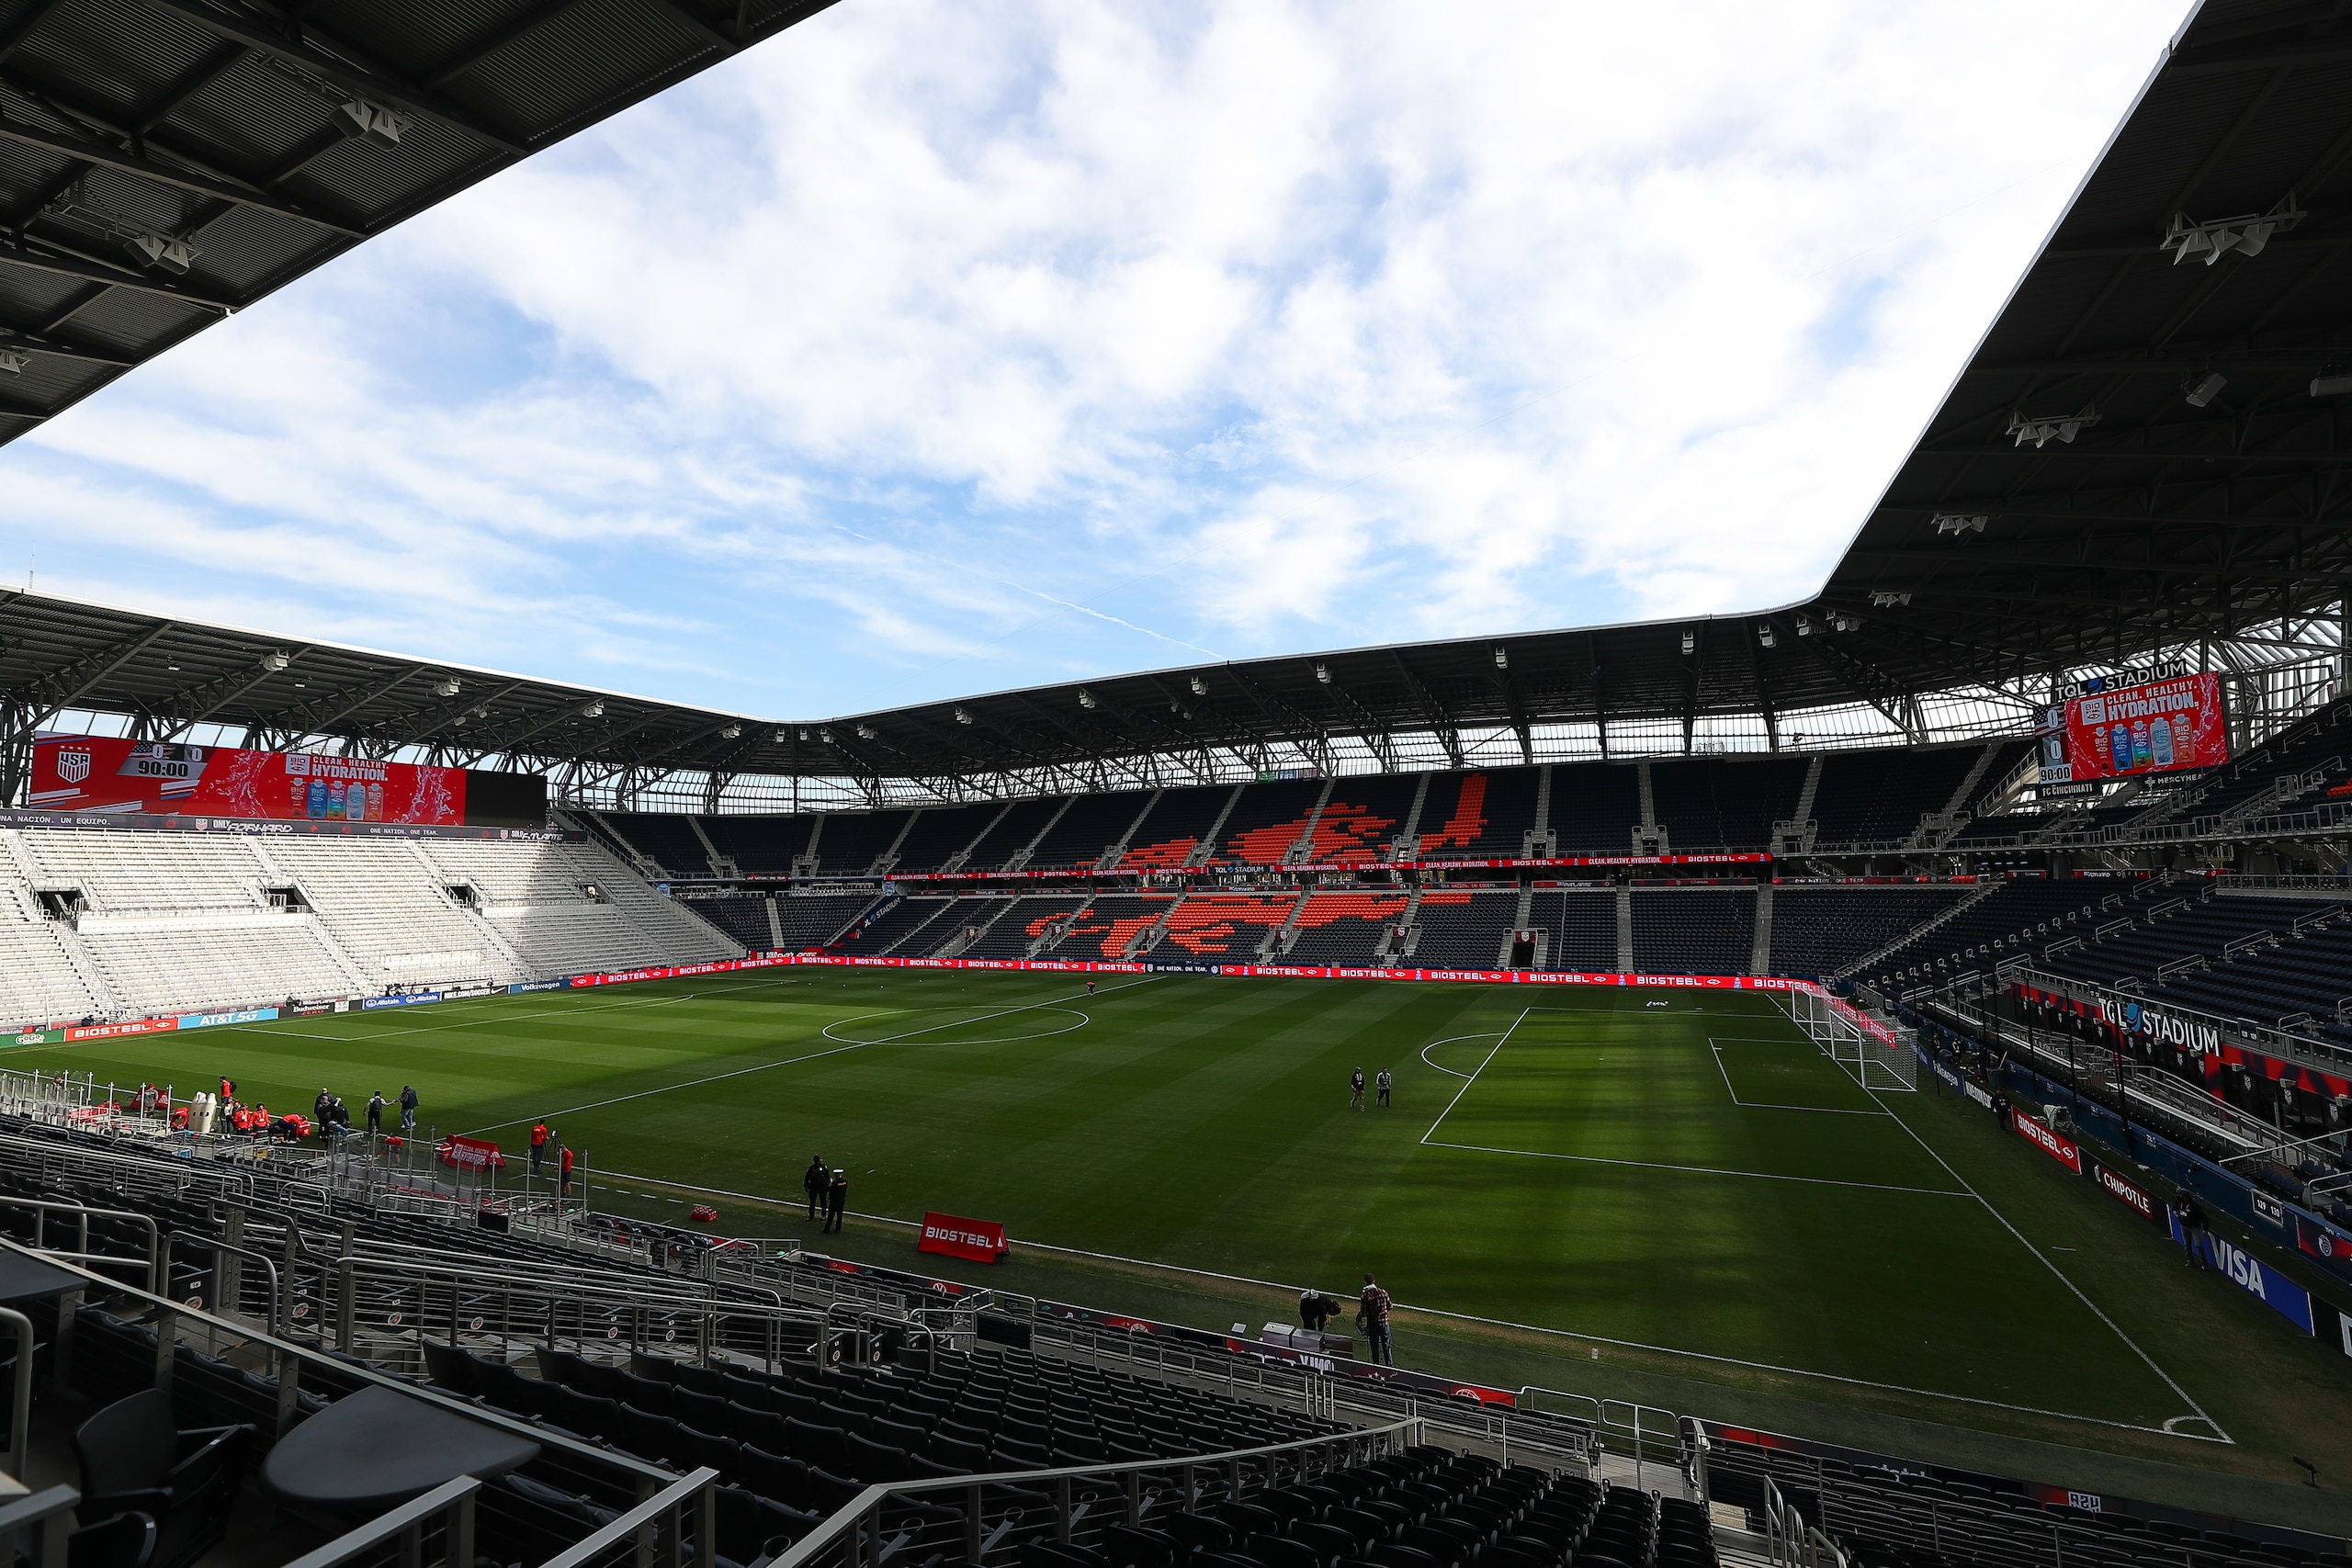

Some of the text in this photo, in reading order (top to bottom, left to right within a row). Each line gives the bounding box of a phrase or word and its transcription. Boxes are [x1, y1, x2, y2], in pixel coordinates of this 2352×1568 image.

[2055, 661, 2186, 700] TQL STADIUM
[2107, 681, 2197, 705] CLEAN. HEALTHY.
[2108, 692, 2199, 721] HYDRATION.
[2047, 709, 2058, 728] 0
[192, 748, 202, 761] 0
[2050, 740, 2062, 759] 0
[61, 753, 89, 766] USA
[313, 756, 390, 769] CLEAN. HEALTHY.
[138, 760, 189, 778] 90:00
[312, 764, 389, 781] HYDRATION.
[2040, 766, 2070, 781] 90:00
[2157, 773, 2206, 784] MERCYHEA
[2042, 784, 2093, 796] FC CINCINNATI
[17, 815, 54, 823] NACIÓN.
[227, 822, 293, 832] FORWARD
[876, 897, 901, 919] STADIUM
[679, 965, 716, 975] BIOSTEEL
[741, 960, 773, 968] BIOSTEEL
[608, 972, 650, 982] BIOSTEEL
[1256, 967, 1304, 976] BIOSTEEL
[1340, 969, 1391, 978] BIOSTEEL
[1431, 972, 1487, 980] BIOSTEEL
[1529, 974, 1589, 983] BIOSTEEL
[1636, 976, 1702, 986] BIOSTEEL
[444, 987, 491, 999] NIKE.COM/SOCCER
[521, 981, 560, 992] Volkswagen
[293, 1003, 330, 1012] Budweiser
[199, 1012, 233, 1026] AT&T
[236, 1010, 258, 1022] 5G
[74, 1023, 151, 1038] BIOSTEEL
[2143, 1010, 2220, 1057] STADIUM
[2017, 1113, 2062, 1154] BIOSTEEL
[2103, 1171, 2151, 1213] CHIPOTLE
[2256, 1199, 2280, 1218] 129 130
[925, 1225, 993, 1248] BIOSTEEL
[2208, 1232, 2266, 1301] VISA
